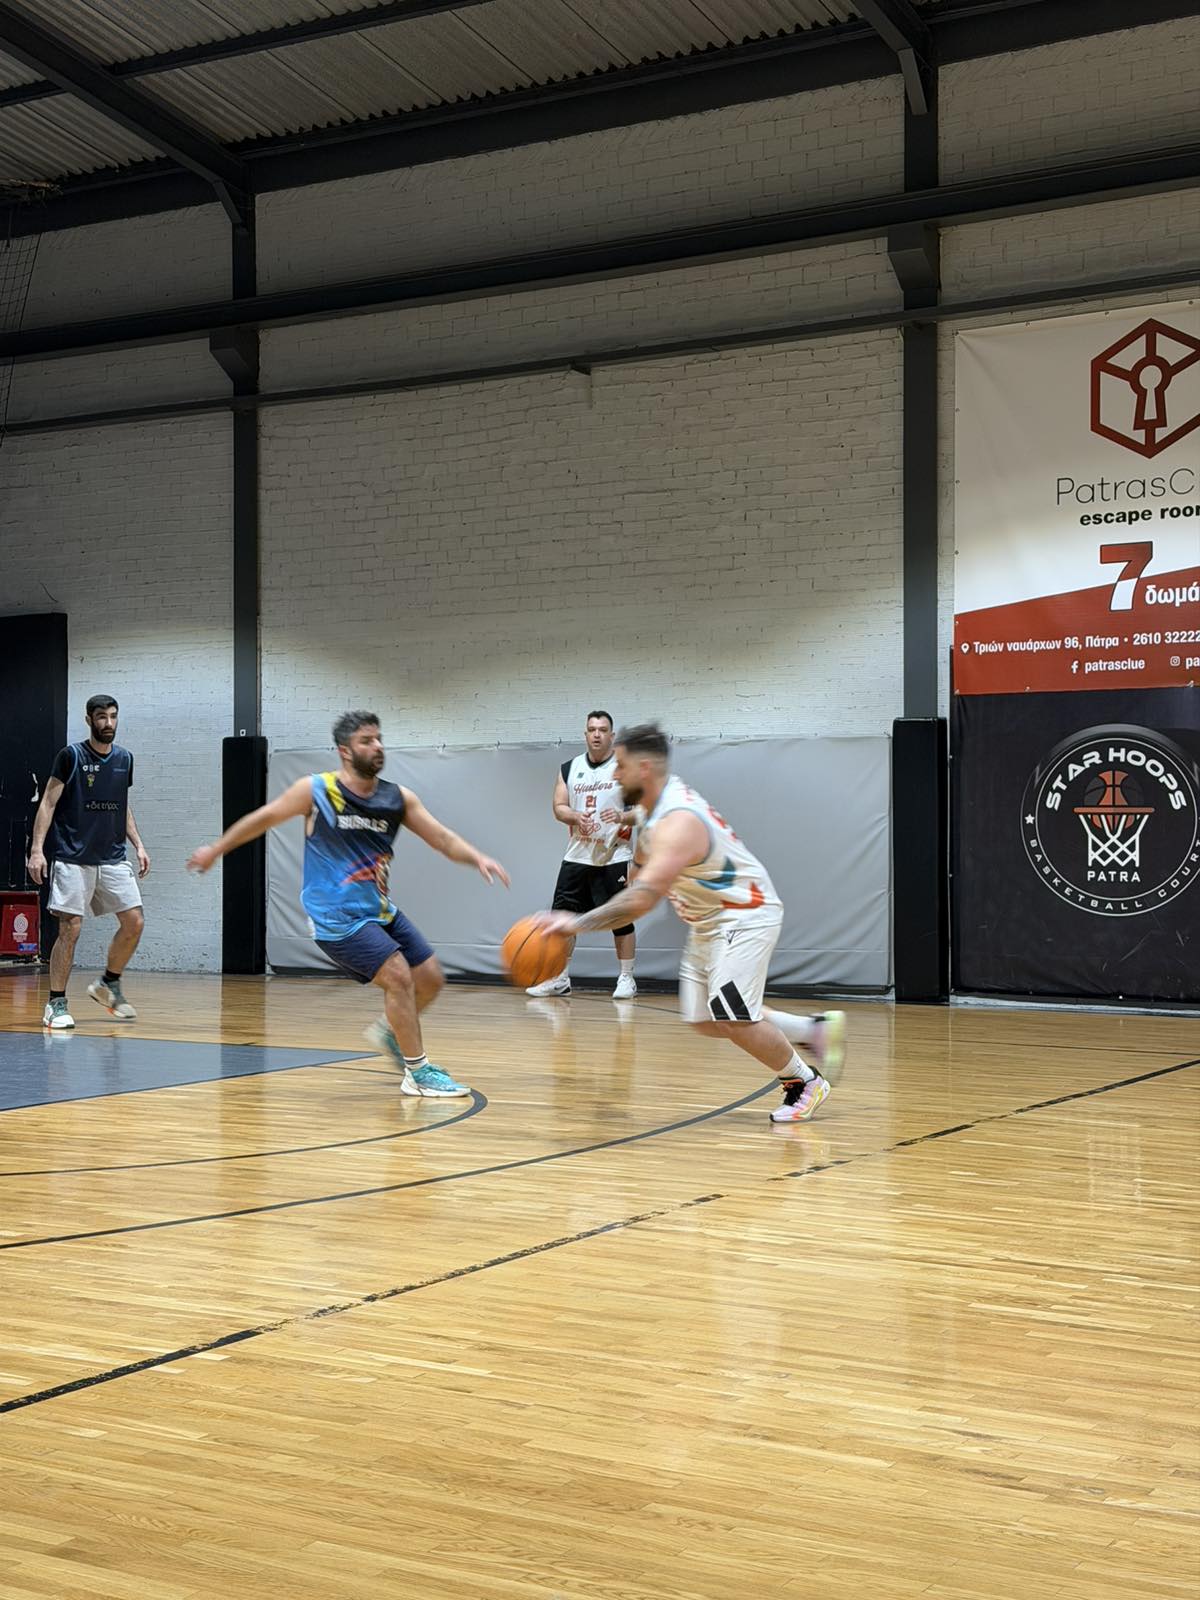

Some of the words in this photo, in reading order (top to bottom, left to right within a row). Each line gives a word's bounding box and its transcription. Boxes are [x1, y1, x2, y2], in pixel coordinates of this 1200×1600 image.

[1056, 468, 1195, 505] PatrasC
[1079, 508, 1153, 525] escape
[1100, 541, 1153, 612] 7
[1144, 581, 1200, 606] δωμά
[973, 640, 1004, 655] Τριών
[1006, 638, 1062, 653] ναυάρχων
[1064, 636, 1082, 650] 96,
[1085, 635, 1119, 649] Πάτρα
[1132, 632, 1161, 645] 2610
[1084, 657, 1145, 674] patrasclue
[1045, 751, 1103, 811] STAR
[1108, 747, 1187, 811] HOOPS
[1029, 839, 1143, 910] BASKETBALL
[1087, 870, 1141, 882] PATRA
